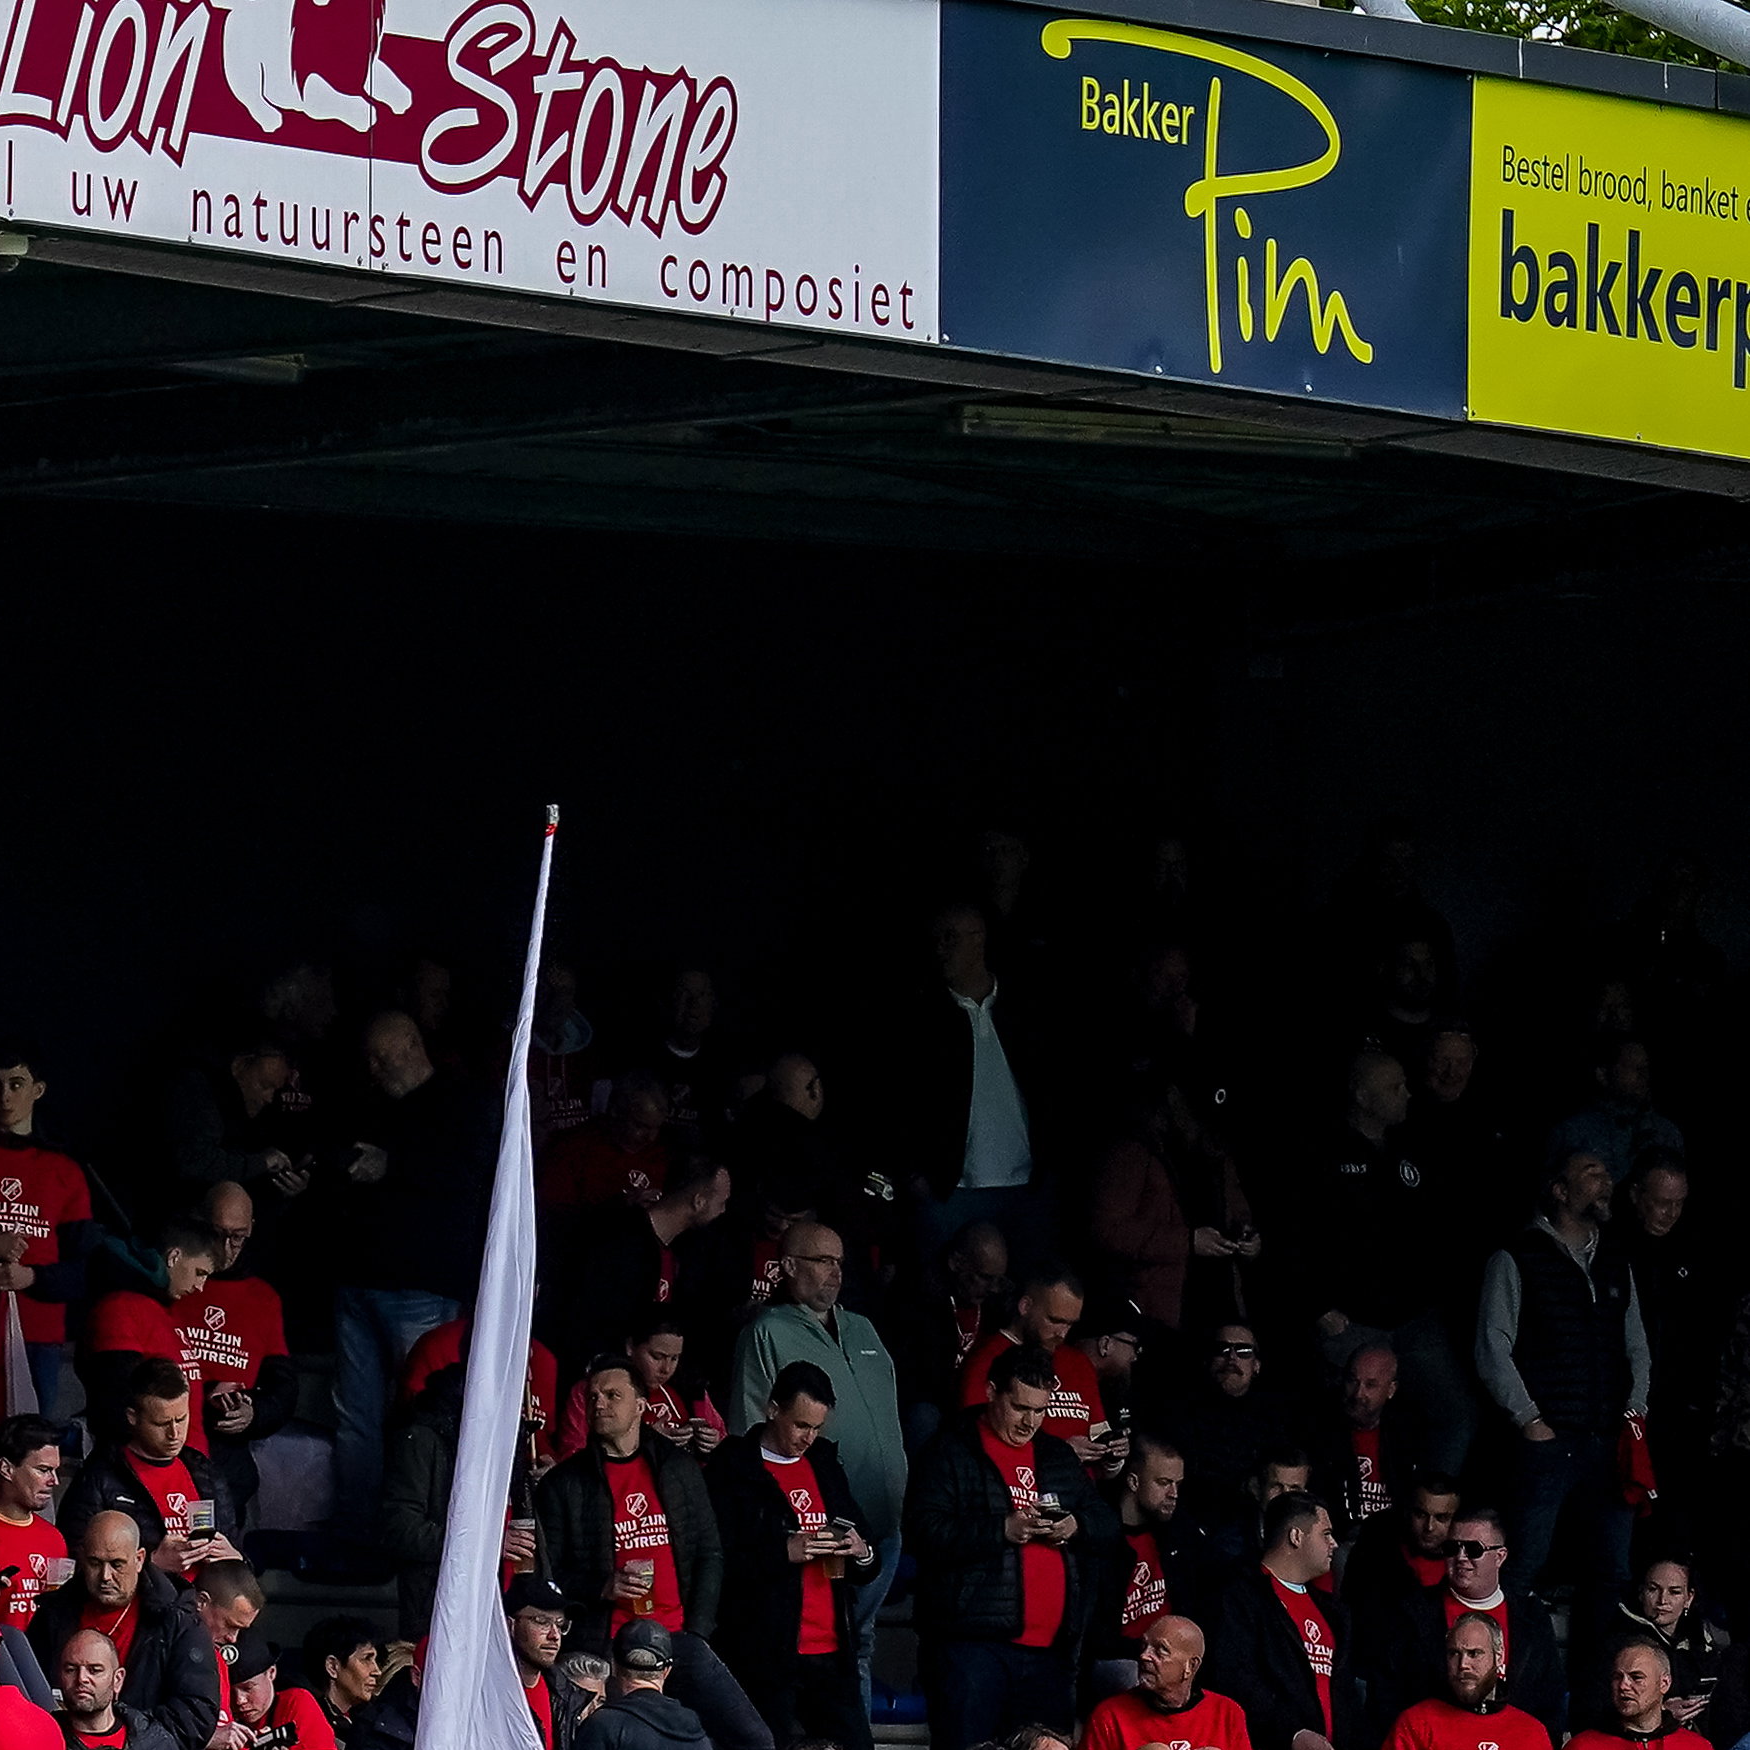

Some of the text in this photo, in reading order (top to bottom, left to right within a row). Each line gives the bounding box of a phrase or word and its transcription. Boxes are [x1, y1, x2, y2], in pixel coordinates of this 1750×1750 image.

[422, 0, 738, 230] Stone
[1081, 76, 1194, 146] Bakker
[1041, 18, 1374, 374] Pim
[1502, 145, 1570, 192] Bestel
[1578, 155, 1652, 212] brood,
[1662, 169, 1739, 221] banket
[72, 170, 138, 222] uw
[191, 184, 503, 275] natuursteen
[557, 237, 607, 288] en
[662, 256, 915, 330] composiet
[11, 1203, 38, 1216] ZIJN
[187, 1327, 241, 1349] WIJ ZIJN
[615, 1514, 668, 1537] WIJ ZIJN
[10, 1601, 27, 1613] FC
